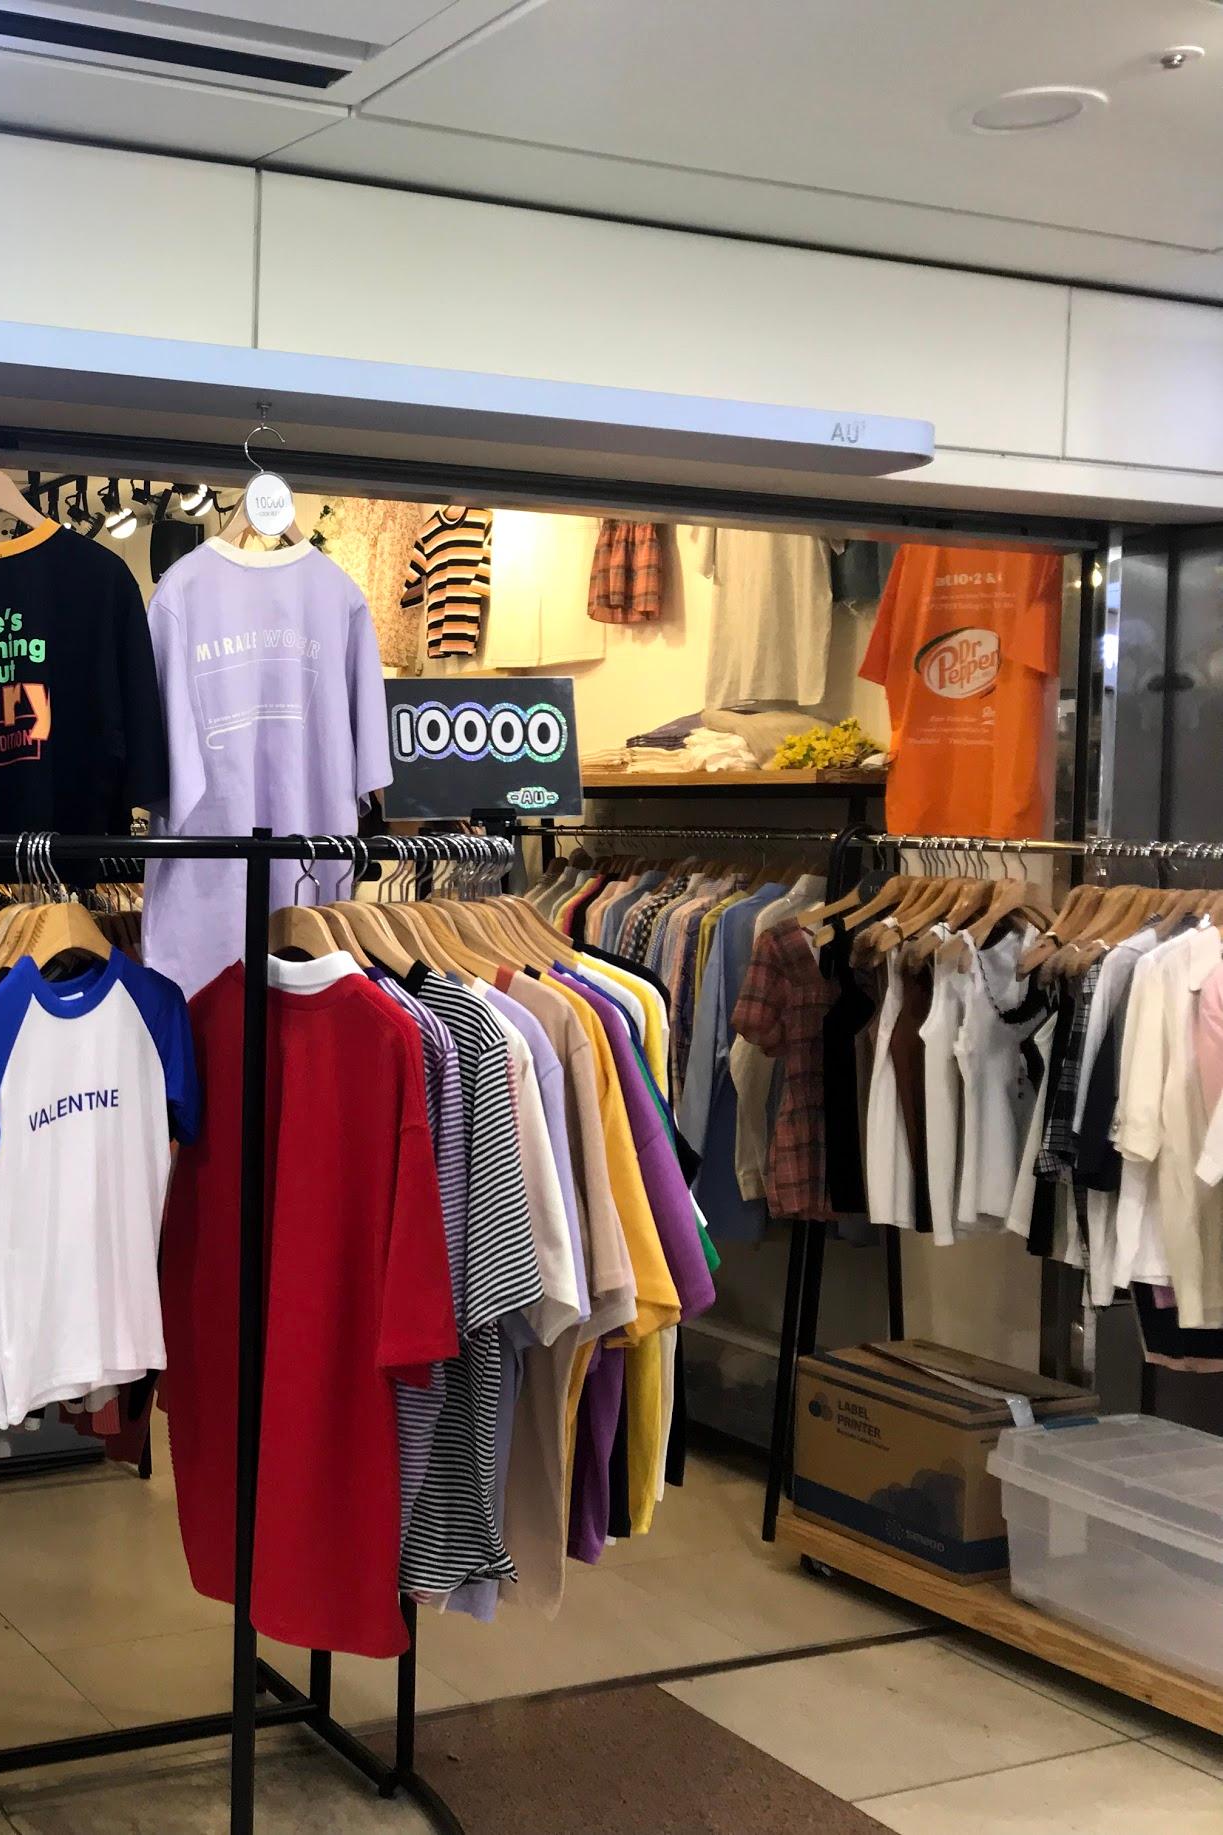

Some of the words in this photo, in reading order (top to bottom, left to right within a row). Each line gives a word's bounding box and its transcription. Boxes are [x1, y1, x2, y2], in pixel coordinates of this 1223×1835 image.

[831, 422, 859, 443] AU
[959, 639, 982, 662] Dr
[393, 702, 567, 761] 10000
[837, 1400, 870, 1420] LABEL
[837, 1413, 882, 1440] PRINTER
